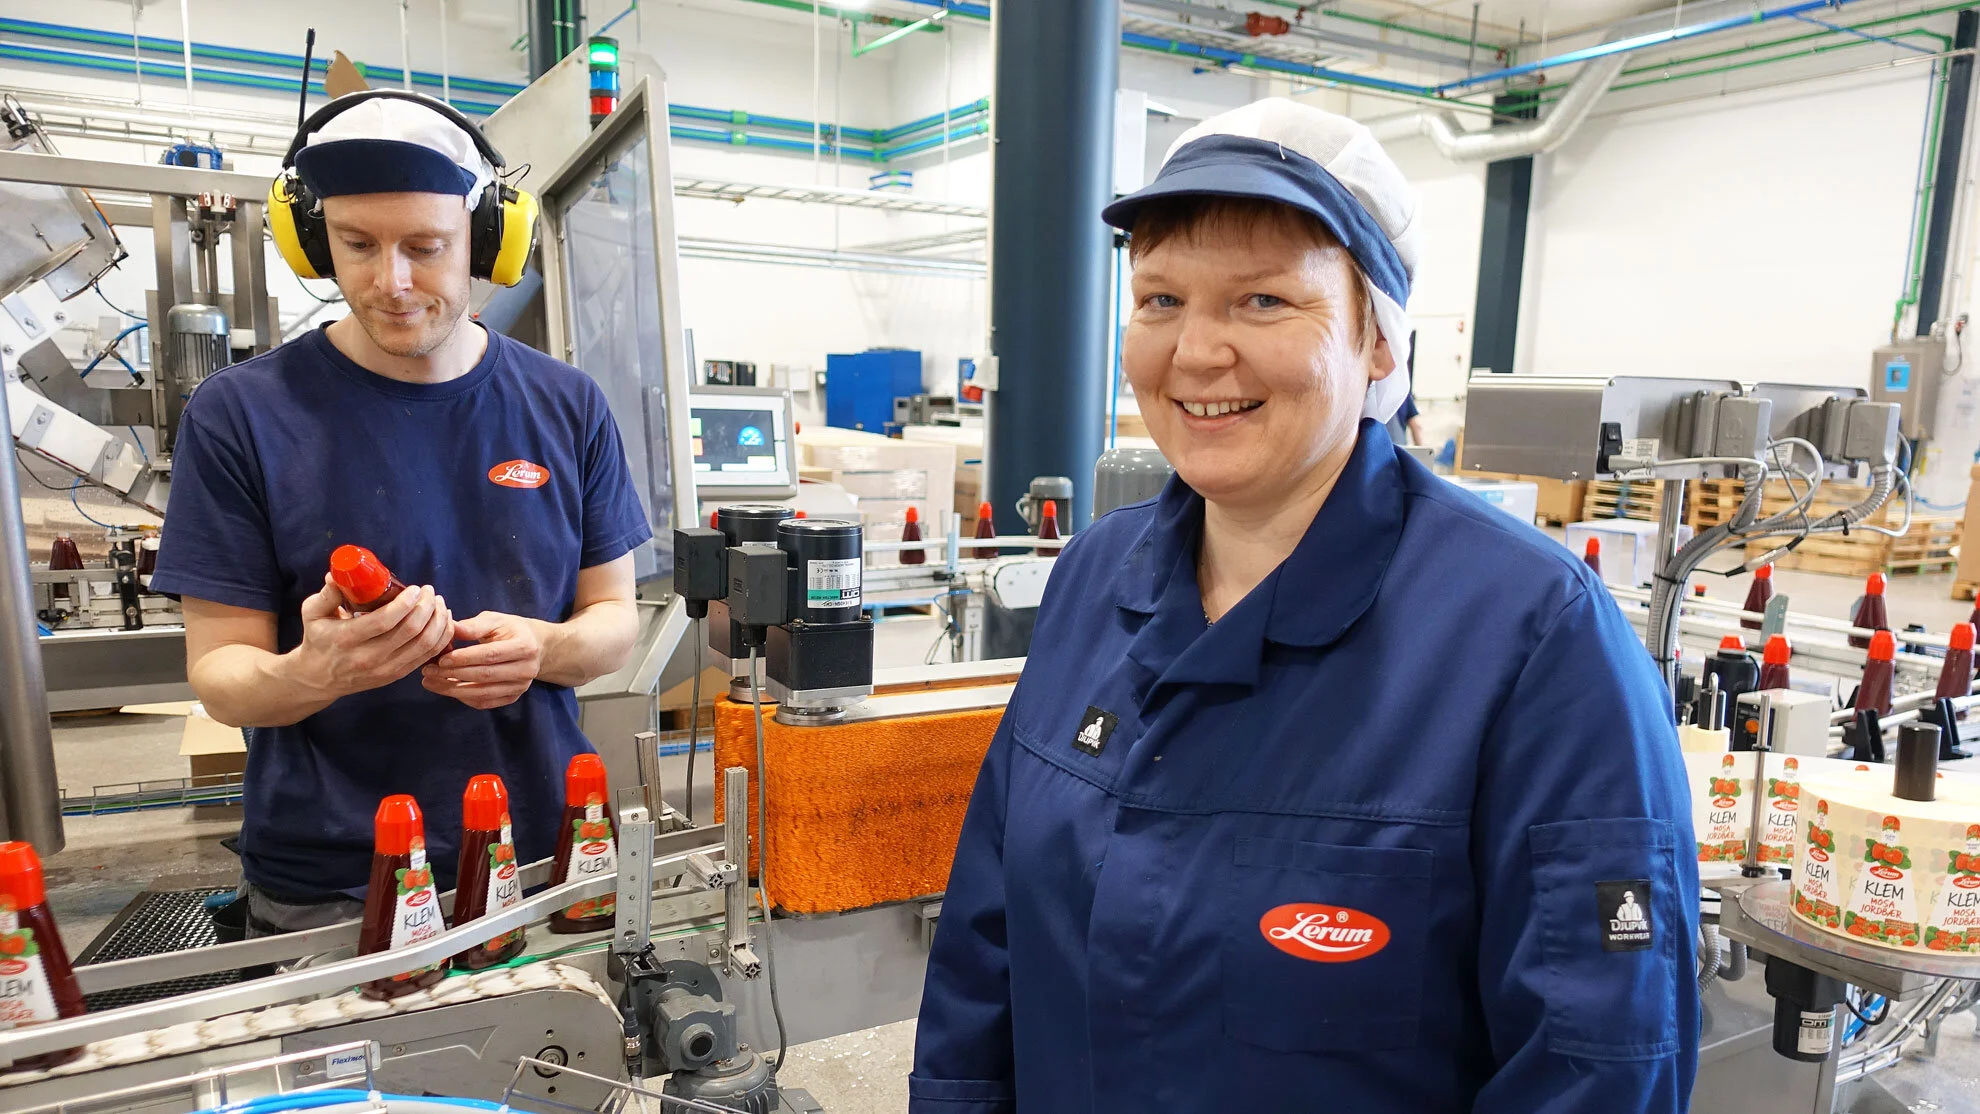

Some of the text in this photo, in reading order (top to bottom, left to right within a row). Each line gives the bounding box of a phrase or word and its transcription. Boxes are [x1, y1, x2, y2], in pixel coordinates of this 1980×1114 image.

[494, 463, 542, 484] Lerum
[1709, 811, 1737, 825] KLEM
[1806, 860, 1830, 882] KLEM
[1864, 880, 1905, 900] KLEM
[1860, 904, 1903, 919] JORDBÆR
[1870, 898, 1896, 908] MOSA
[1954, 909, 1976, 917] MOSA
[404, 905, 436, 930] KLEM
[1269, 911, 1374, 953] Lerum
